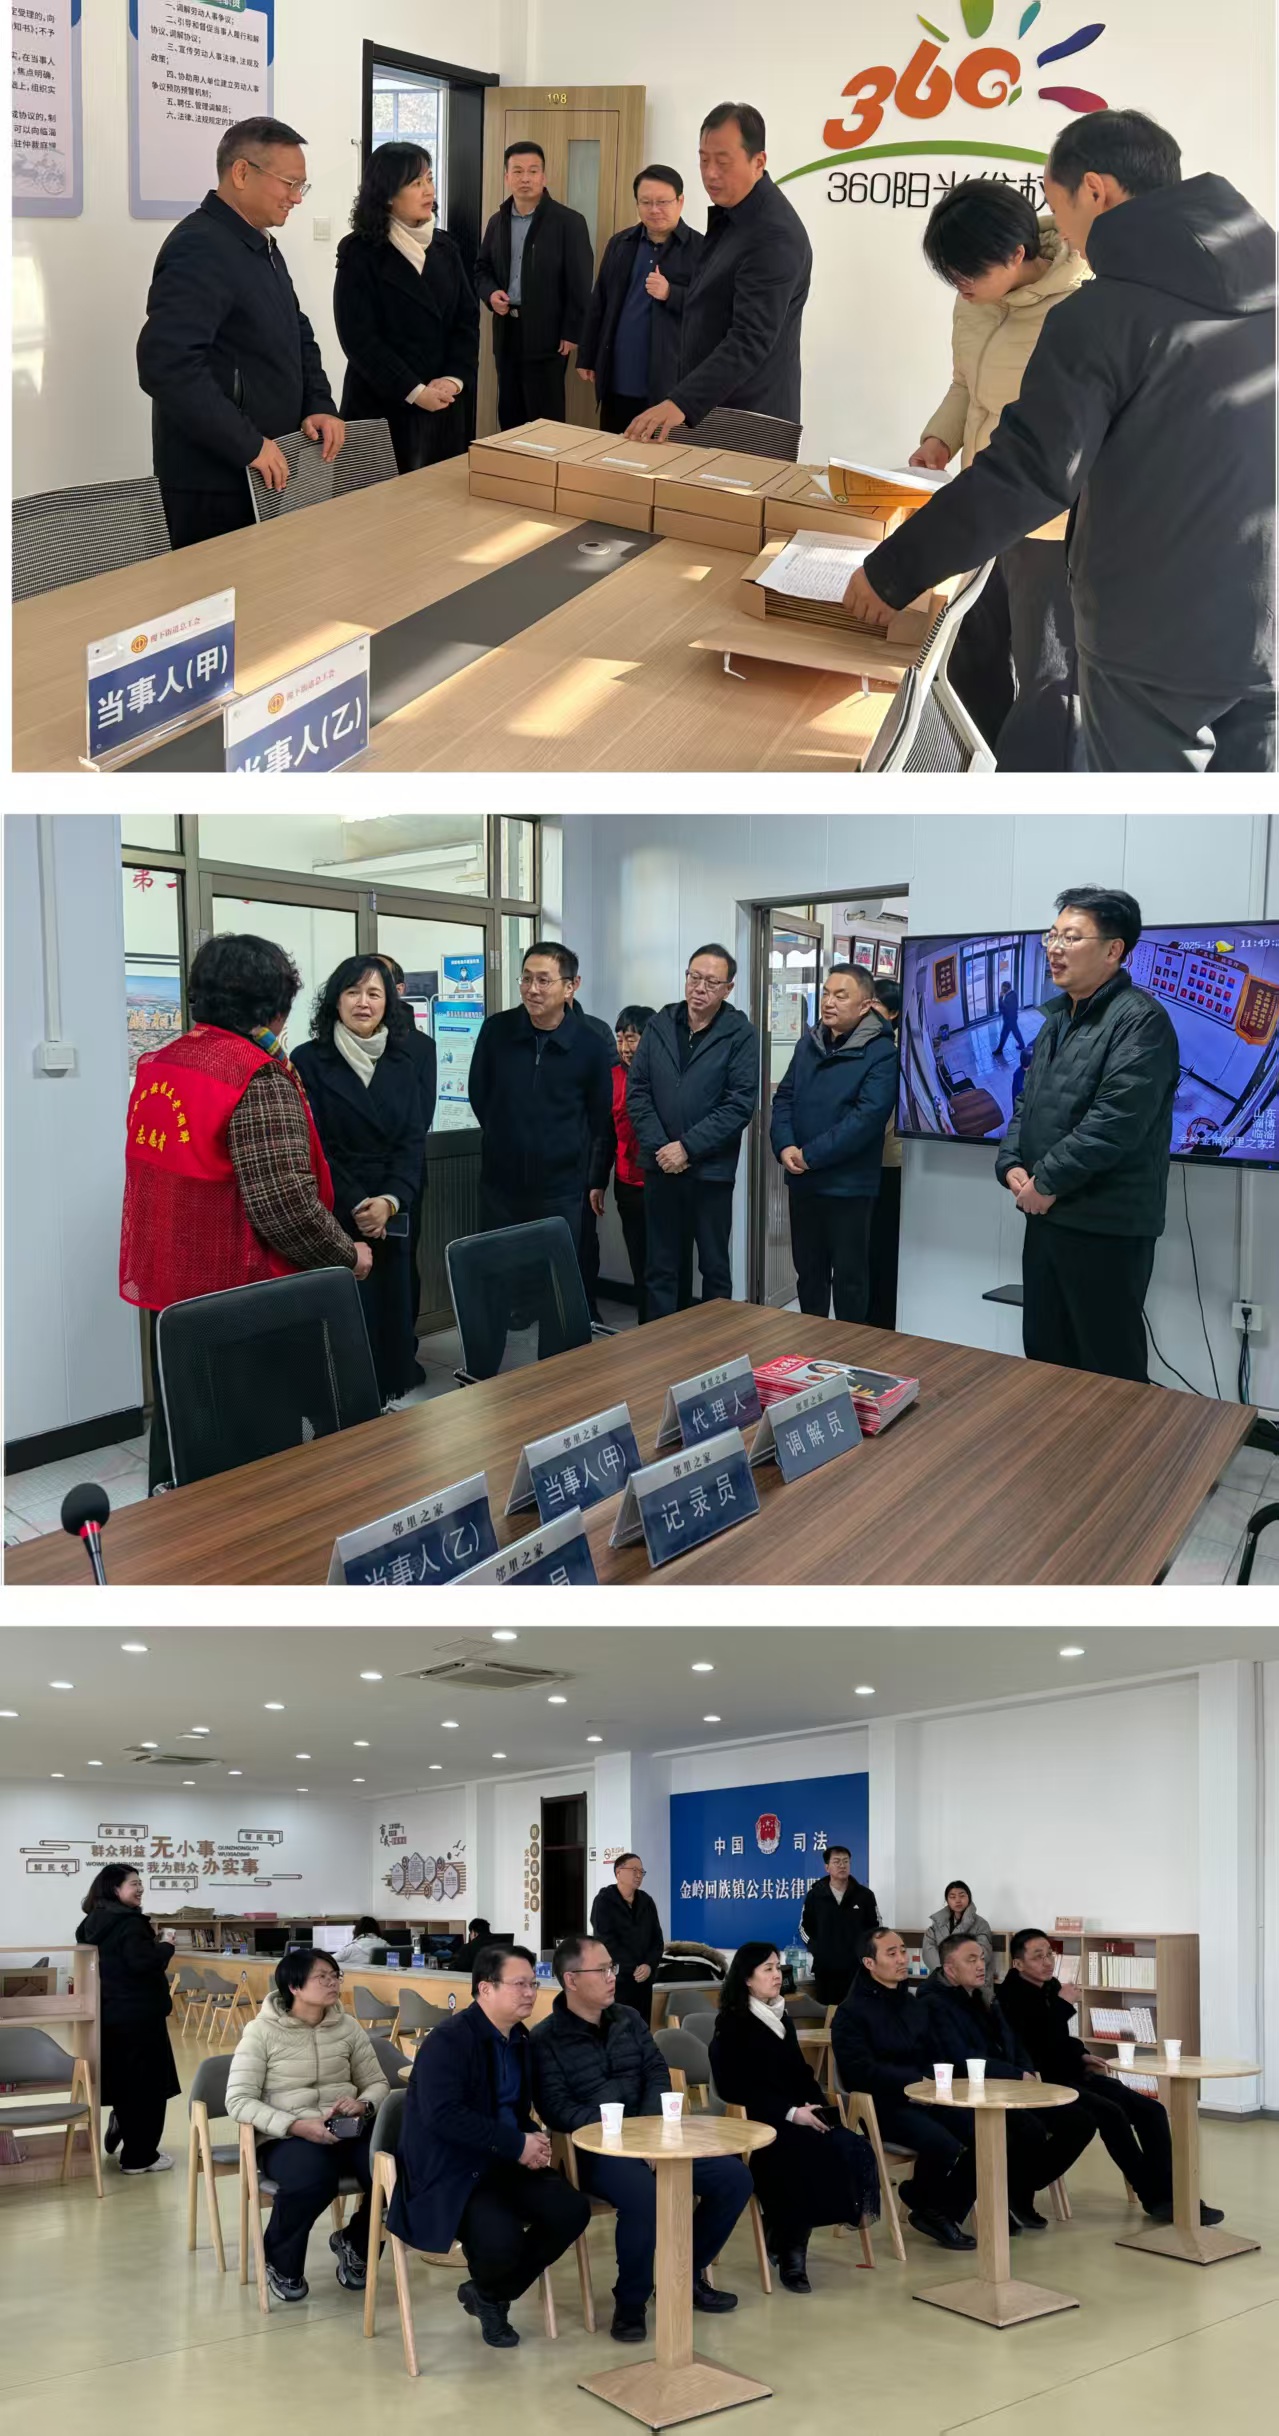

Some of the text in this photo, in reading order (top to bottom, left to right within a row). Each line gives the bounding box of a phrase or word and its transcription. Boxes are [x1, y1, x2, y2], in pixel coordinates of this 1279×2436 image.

[12, 22, 55, 37] 知书》；不予
[547, 93, 567, 104] 108
[822, 39, 1021, 150] 360
[827, 171, 1046, 212] 360阳光权
[97, 645, 228, 730] 当事人(甲)
[1254, 1108, 1277, 1120] 山东
[692, 1390, 746, 1434] 代理人
[563, 1425, 601, 1448] 邻里之家
[786, 1410, 845, 1457] 调解员
[544, 1443, 627, 1505] 当事人(甲)
[673, 1451, 712, 1477] 邻里之家
[392, 1502, 445, 1536] 邻里之家
[661, 1472, 737, 1534] 记录员
[495, 1542, 545, 1583] 邻里之家
[714, 1835, 744, 1856] 中国
[793, 1830, 828, 1853] 司法
